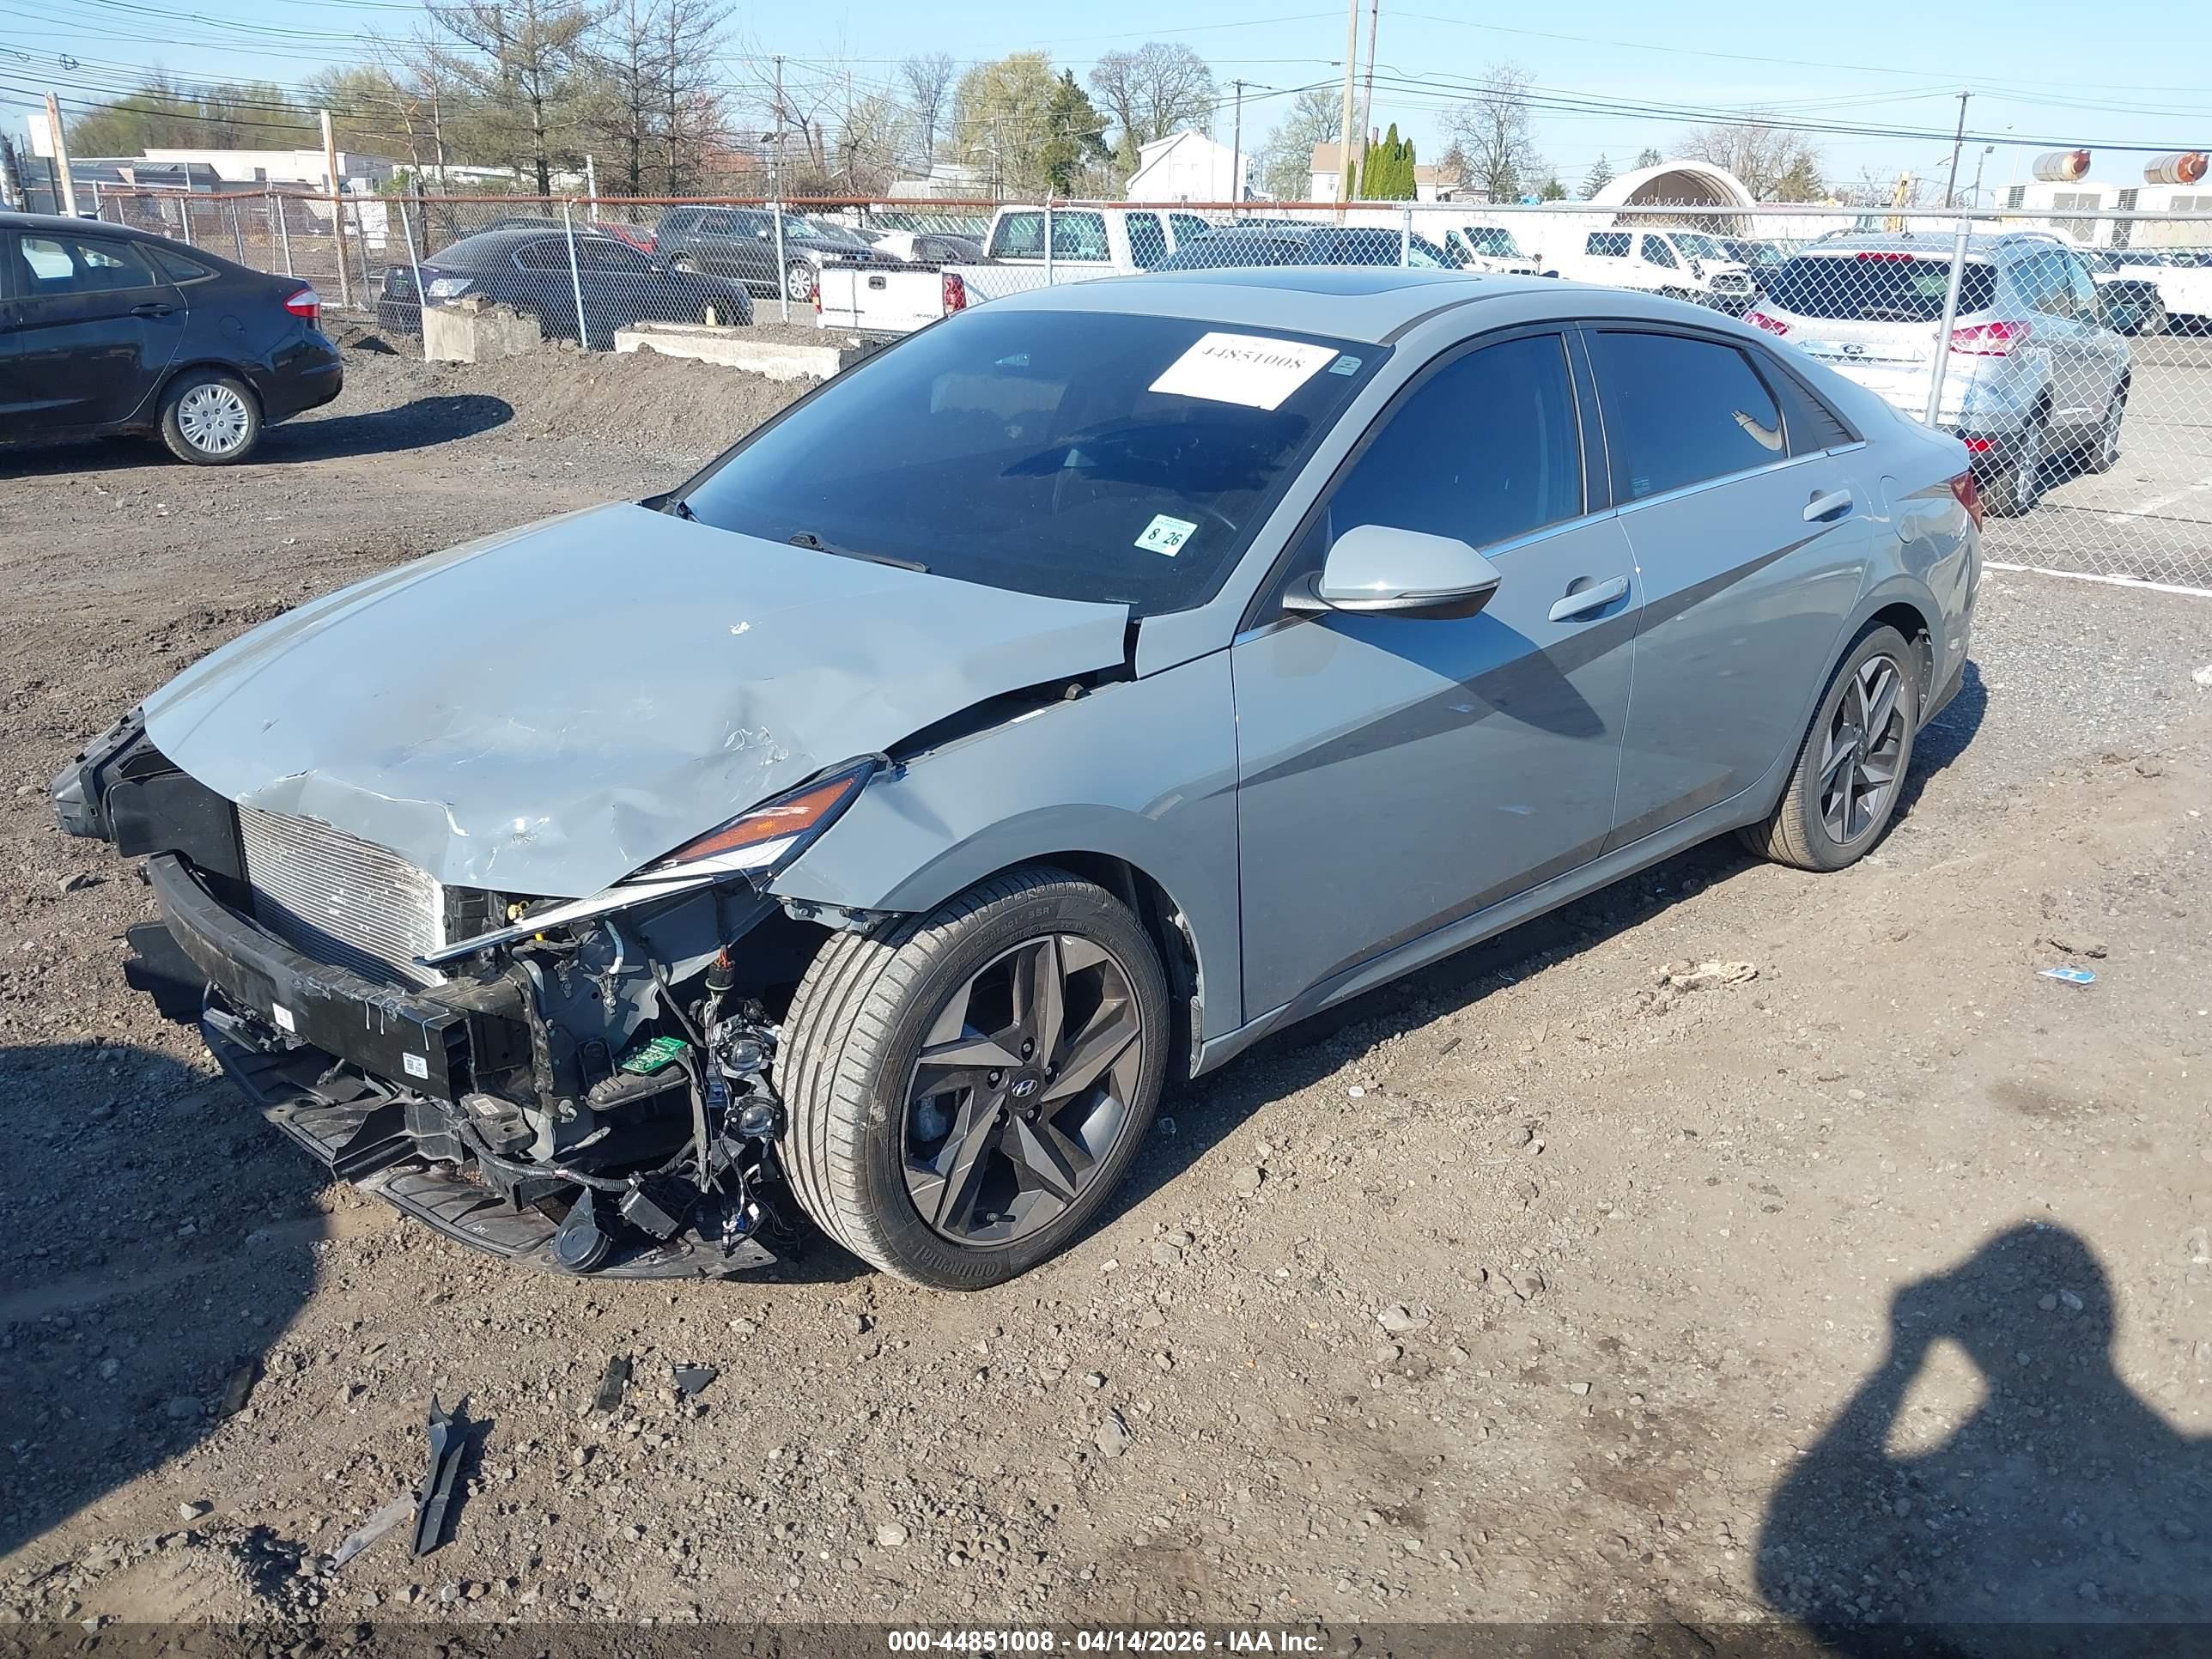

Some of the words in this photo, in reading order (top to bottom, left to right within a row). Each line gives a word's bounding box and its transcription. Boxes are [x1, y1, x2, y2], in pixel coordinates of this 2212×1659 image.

[1202, 346, 1306, 369] 44851008
[1148, 527, 1161, 540] 8
[1163, 532, 1183, 546] 26
